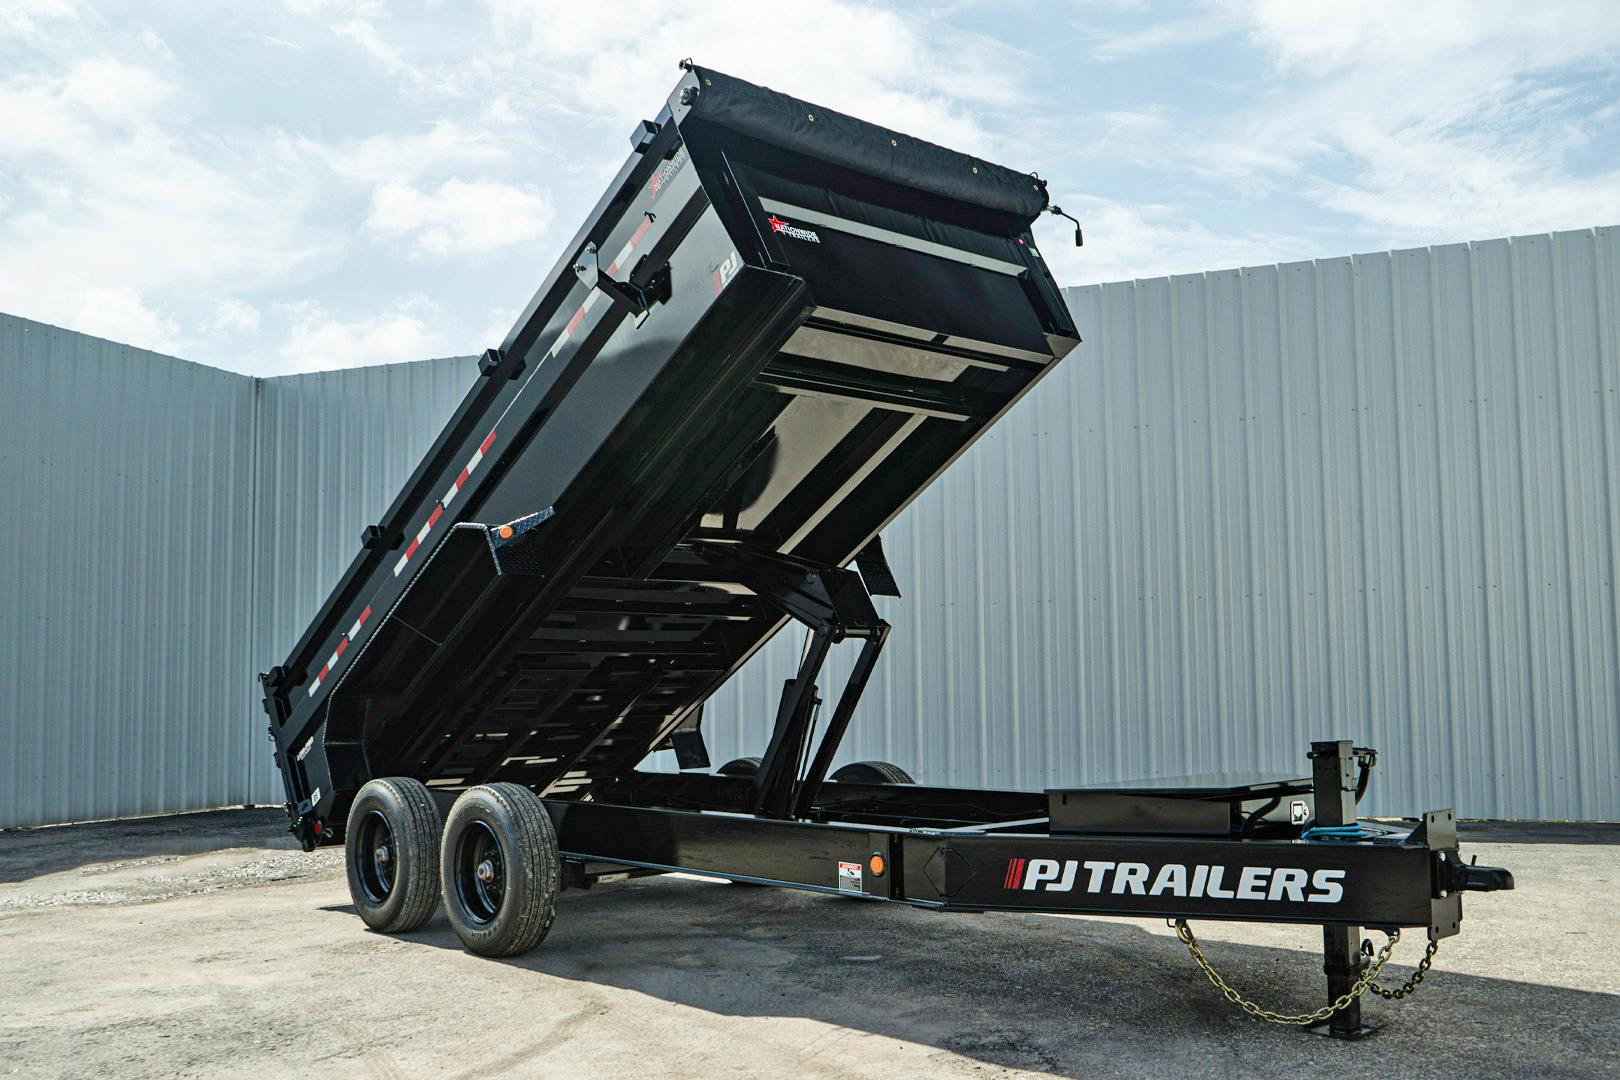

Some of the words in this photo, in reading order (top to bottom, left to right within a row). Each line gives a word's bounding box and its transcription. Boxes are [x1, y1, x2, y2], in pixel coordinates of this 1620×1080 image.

[719, 250, 738, 284] PJ
[1023, 859, 1078, 891] PJ
[1084, 861, 1345, 903] TRAILERS
